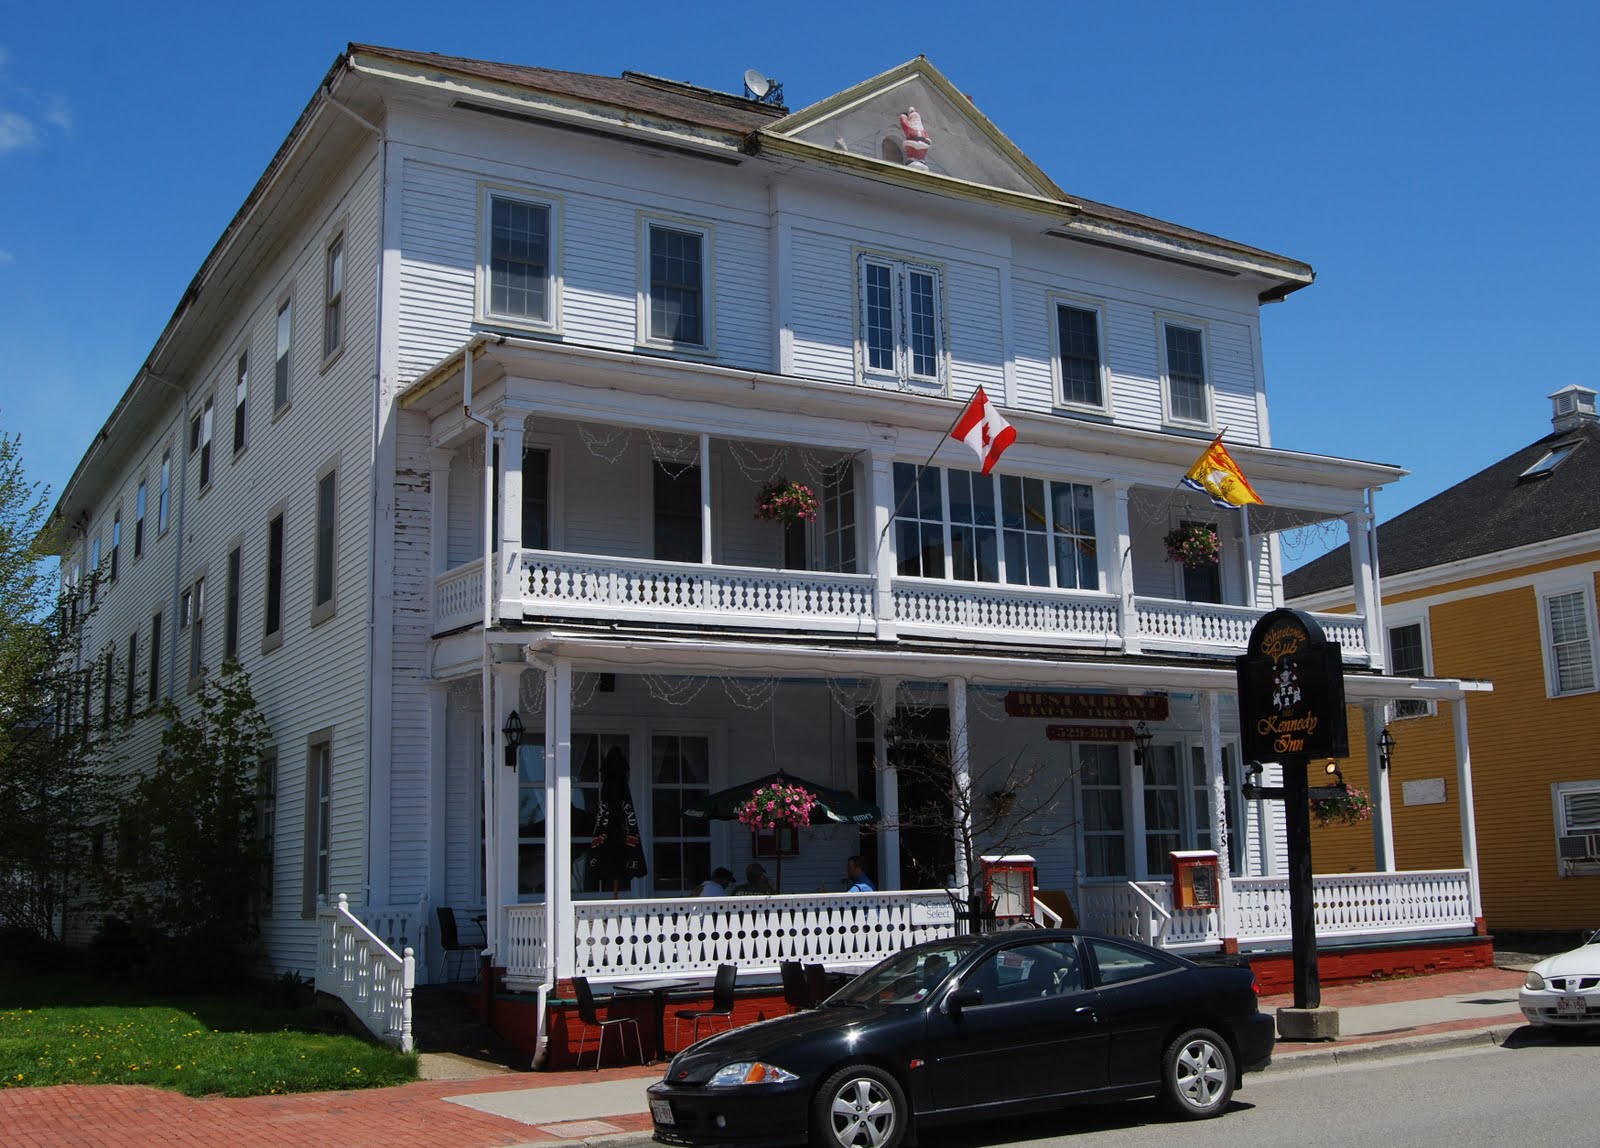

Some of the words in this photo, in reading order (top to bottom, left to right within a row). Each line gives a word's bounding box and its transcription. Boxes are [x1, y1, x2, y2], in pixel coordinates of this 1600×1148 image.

[1268, 639, 1297, 665] Pub
[1018, 693, 1157, 710] RESTAURANT
[1258, 710, 1318, 735] Kennedy
[1274, 734, 1304, 753] Inn
[926, 899, 952, 910] Canad
[926, 909, 950, 919] Select
